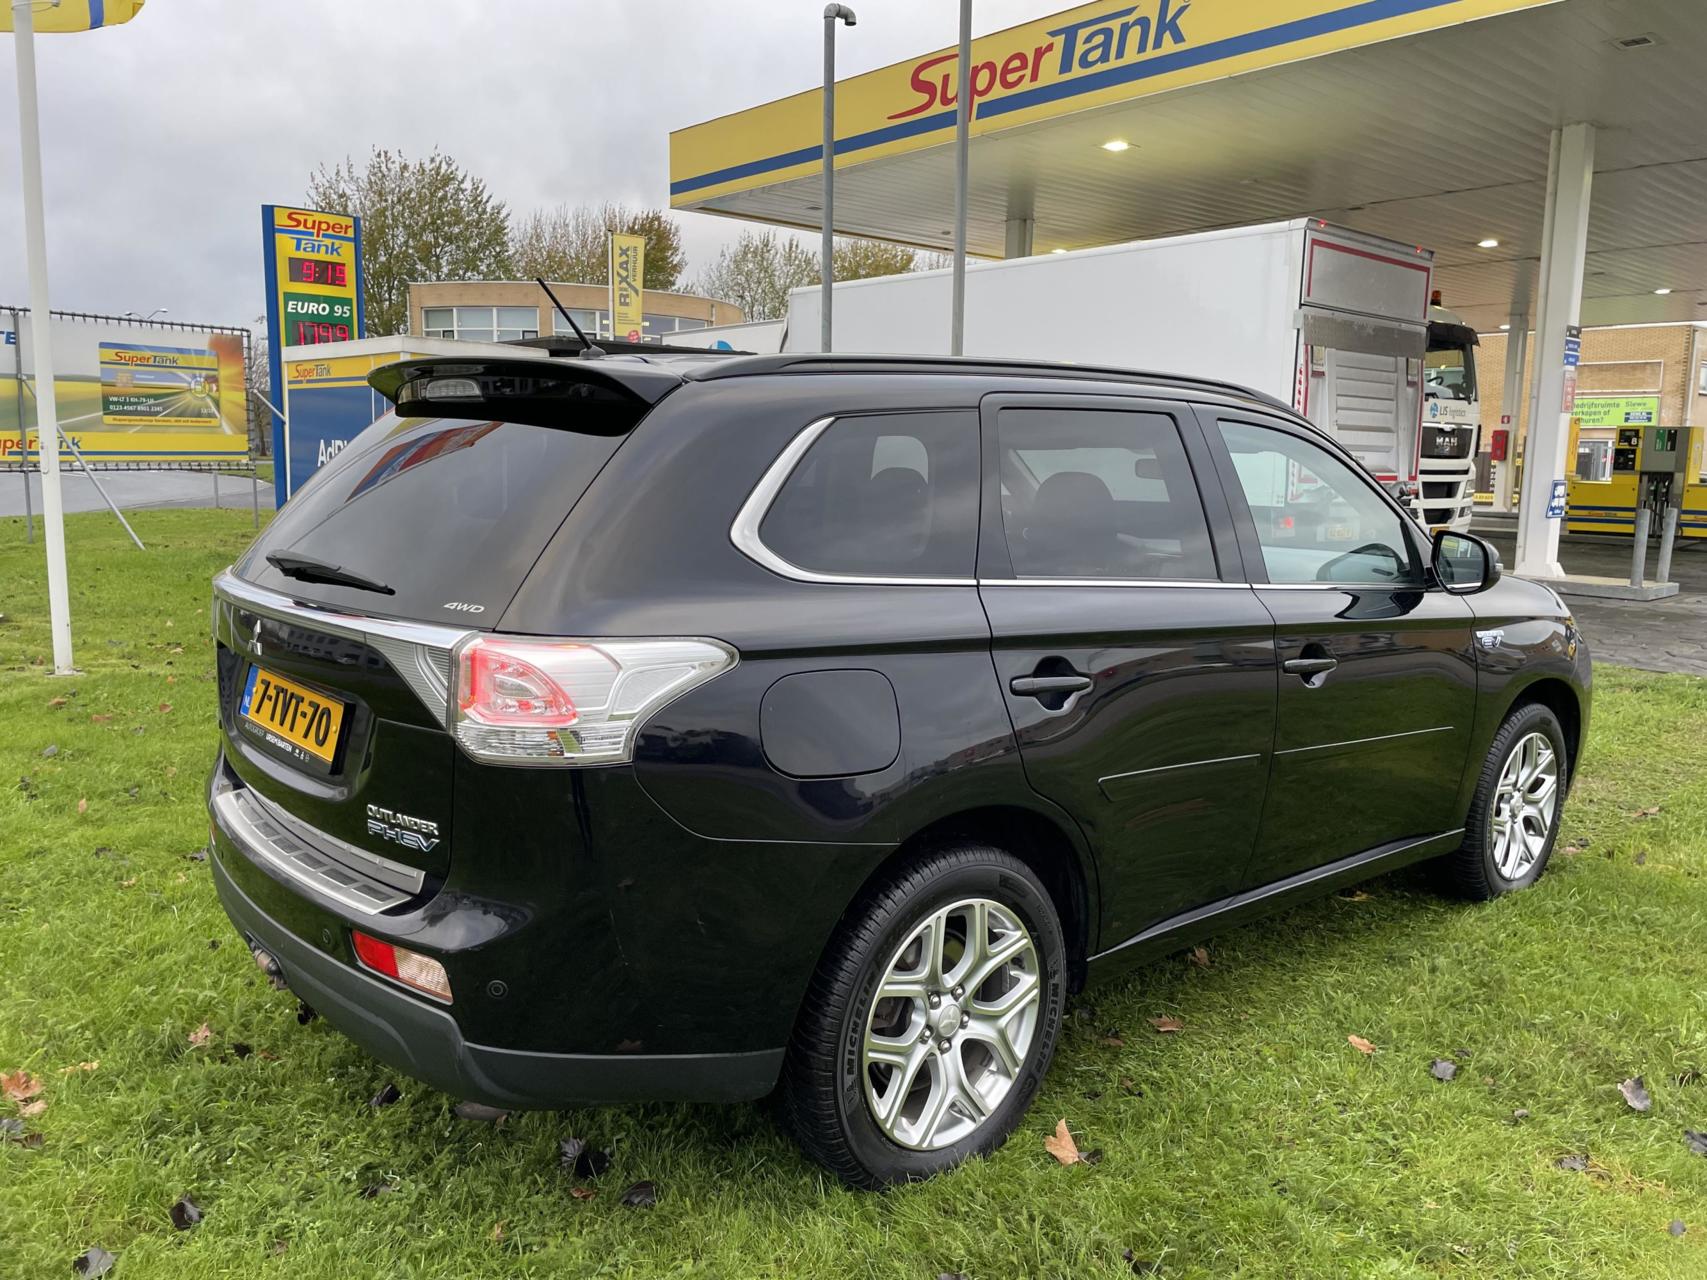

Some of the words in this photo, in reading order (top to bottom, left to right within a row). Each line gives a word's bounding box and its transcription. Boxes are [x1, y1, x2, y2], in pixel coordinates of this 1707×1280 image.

[886, 0, 1191, 122] SuperTank
[276, 211, 353, 238] Super
[288, 236, 342, 257] Tank
[616, 246, 639, 307] RIXAX
[287, 300, 330, 316] EURO
[333, 304, 351, 318] 95
[109, 350, 179, 367] SuperTank
[292, 363, 332, 380] SuperTank
[1631, 437, 1639, 446] 8
[443, 602, 485, 613] 4WD
[255, 678, 332, 748] 7-TVT-70
[367, 804, 439, 835] OUTLANDER
[367, 819, 440, 853] PHEV
